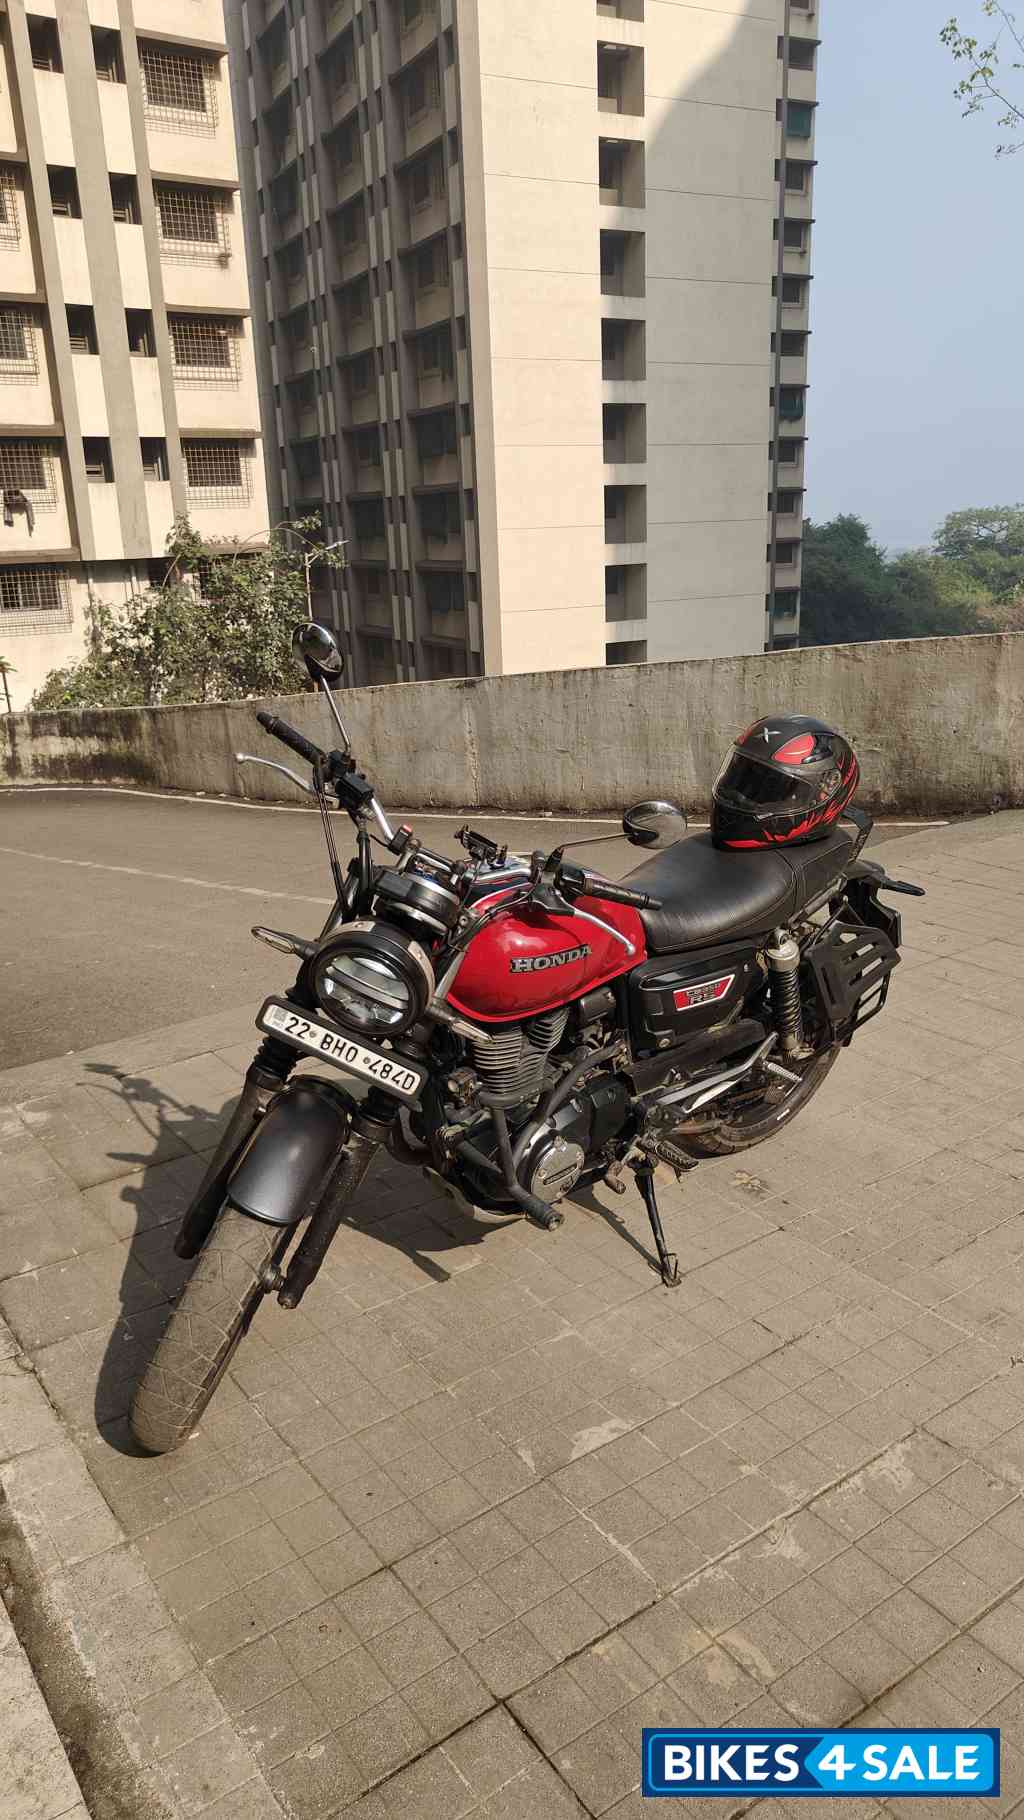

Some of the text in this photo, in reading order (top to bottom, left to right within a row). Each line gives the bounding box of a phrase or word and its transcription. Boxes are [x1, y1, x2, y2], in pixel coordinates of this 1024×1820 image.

[510, 944, 592, 973] HONDA
[284, 1016, 311, 1040] 22
[368, 1059, 416, 1091] 484D
